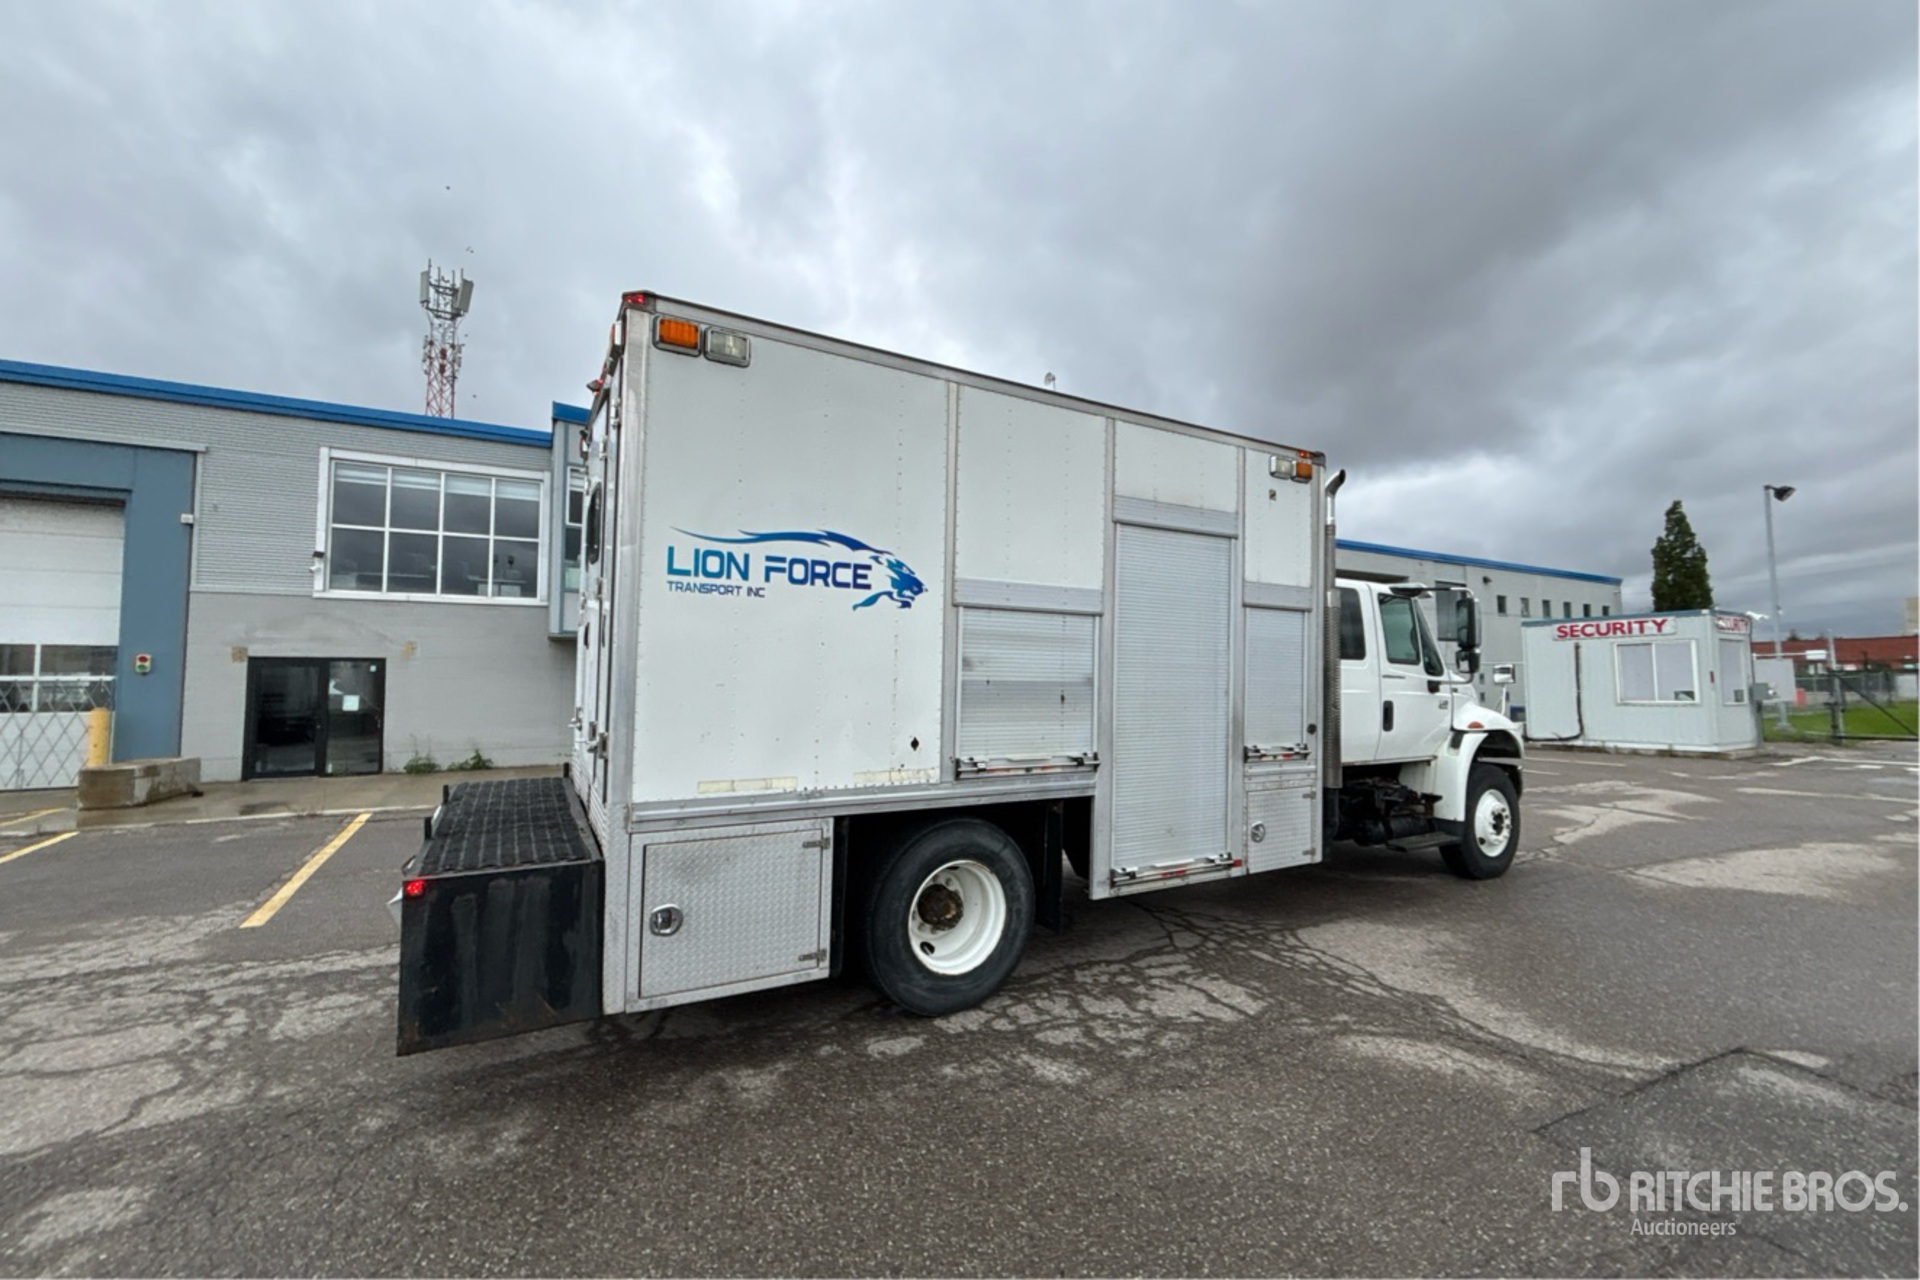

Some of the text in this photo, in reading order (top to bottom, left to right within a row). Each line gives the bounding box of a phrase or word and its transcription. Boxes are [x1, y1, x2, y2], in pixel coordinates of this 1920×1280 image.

[667, 546, 872, 590] LION FORCE
[667, 580, 765, 598] TRANSPORT INC
[1557, 619, 1668, 638] SECURITY
